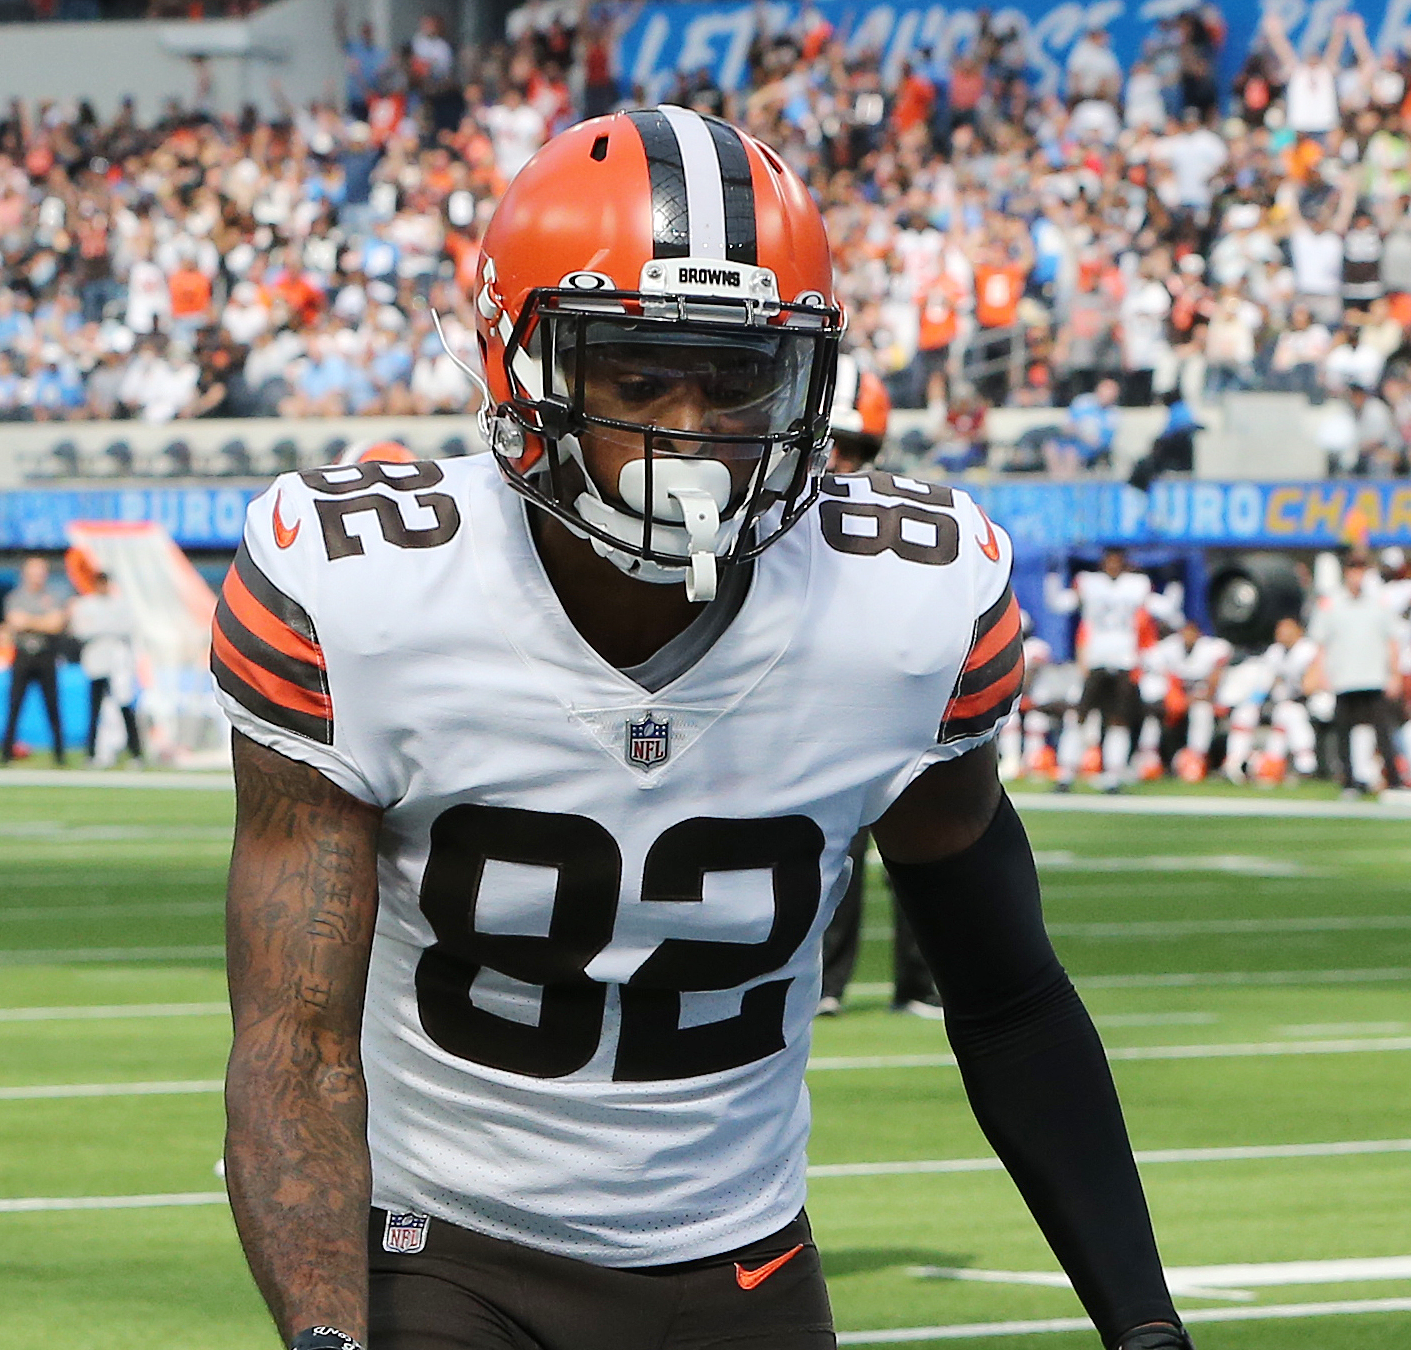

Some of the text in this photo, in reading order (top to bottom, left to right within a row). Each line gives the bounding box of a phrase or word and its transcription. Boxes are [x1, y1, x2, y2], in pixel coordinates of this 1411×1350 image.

[679, 267, 741, 288] BROWNS
[298, 460, 461, 561] 82
[632, 740, 664, 761] NFL
[415, 803, 826, 1082] 82
[390, 1228, 419, 1249] NFL
